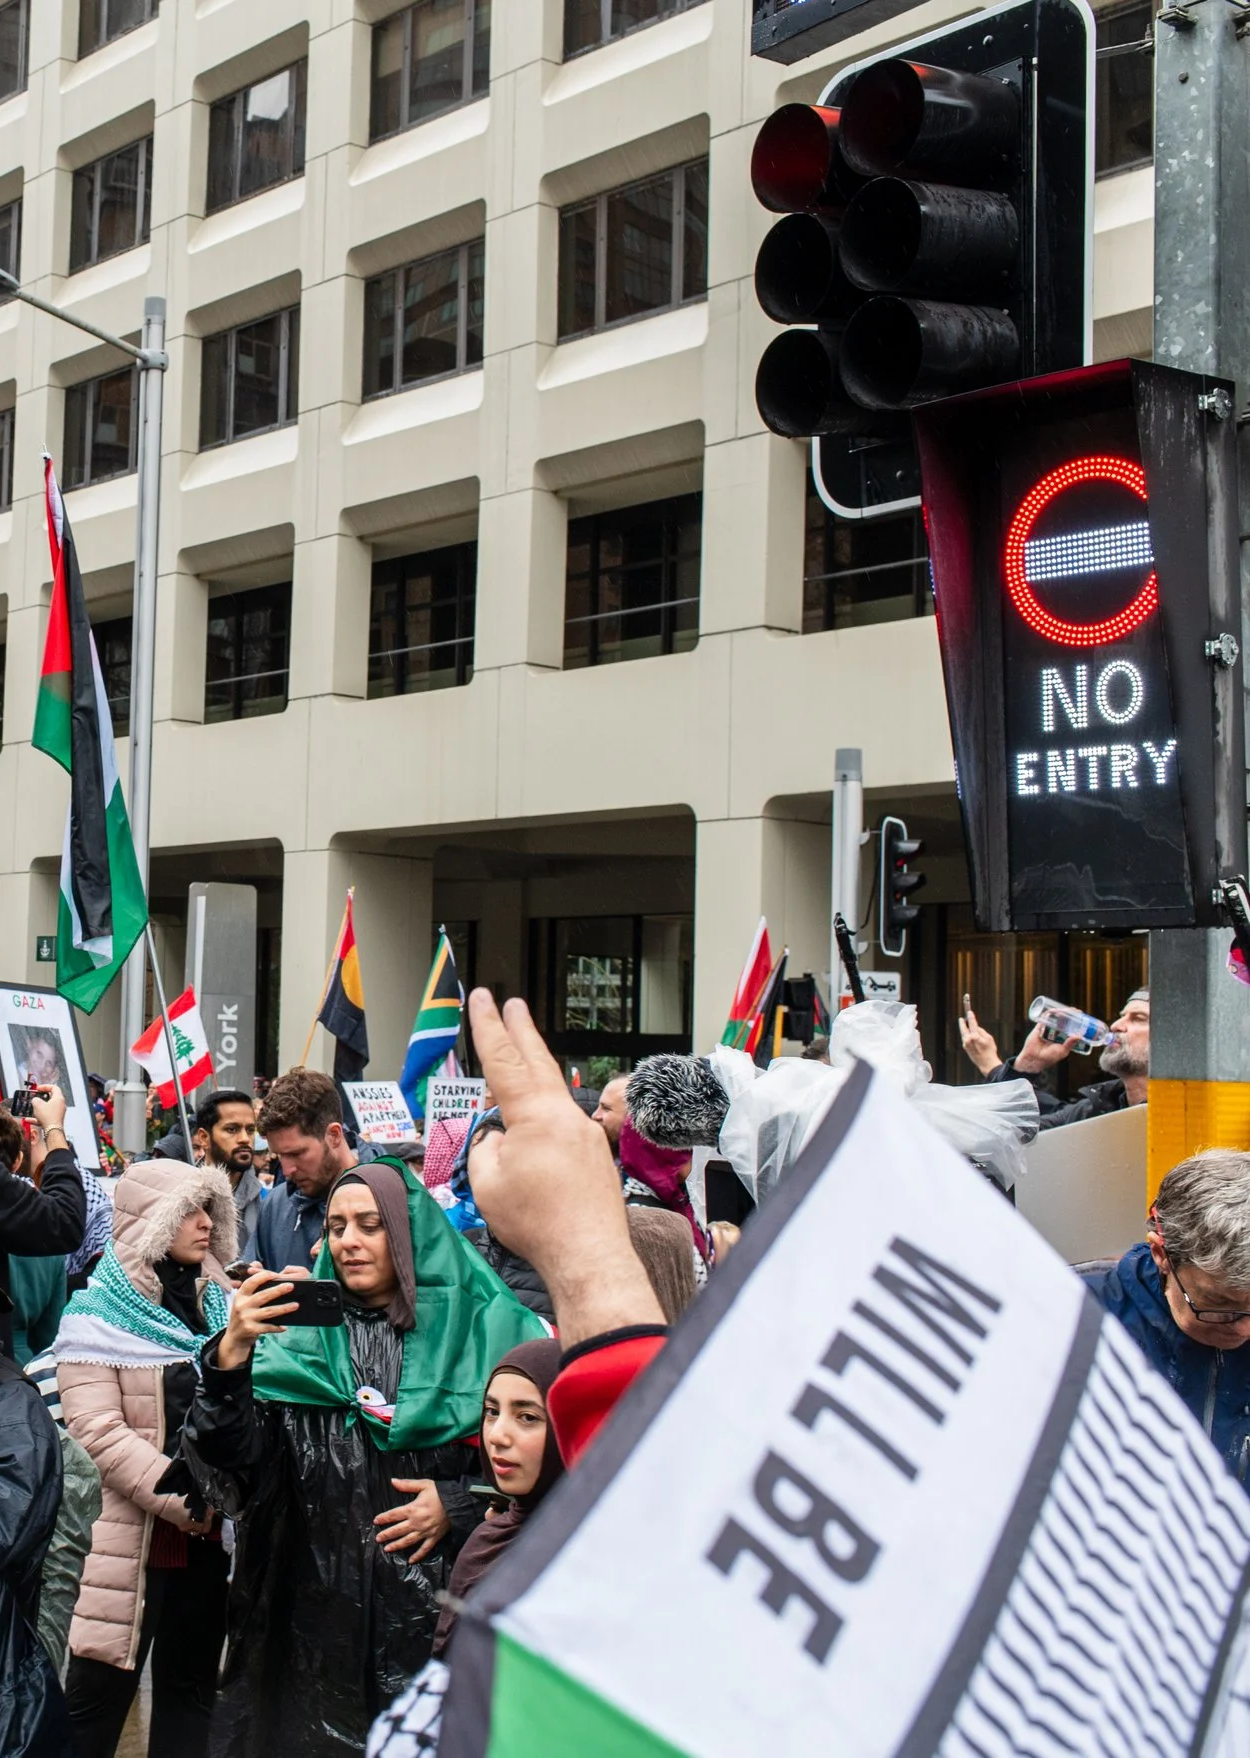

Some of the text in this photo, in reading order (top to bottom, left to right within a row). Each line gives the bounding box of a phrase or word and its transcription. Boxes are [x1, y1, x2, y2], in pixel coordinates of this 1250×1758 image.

[1041, 660, 1144, 732] NO
[1015, 738, 1178, 796] ENTRY
[12, 994, 46, 1010] GAZA
[216, 1003, 238, 1073] York
[433, 1085, 482, 1096] STARVING
[357, 1100, 395, 1112] AGAINST
[432, 1098, 478, 1109] CHILDREN
[363, 1110, 407, 1124] APARTHEID
[451, 1111, 469, 1119] NOT
[704, 1235, 1003, 1667] WILL BE
